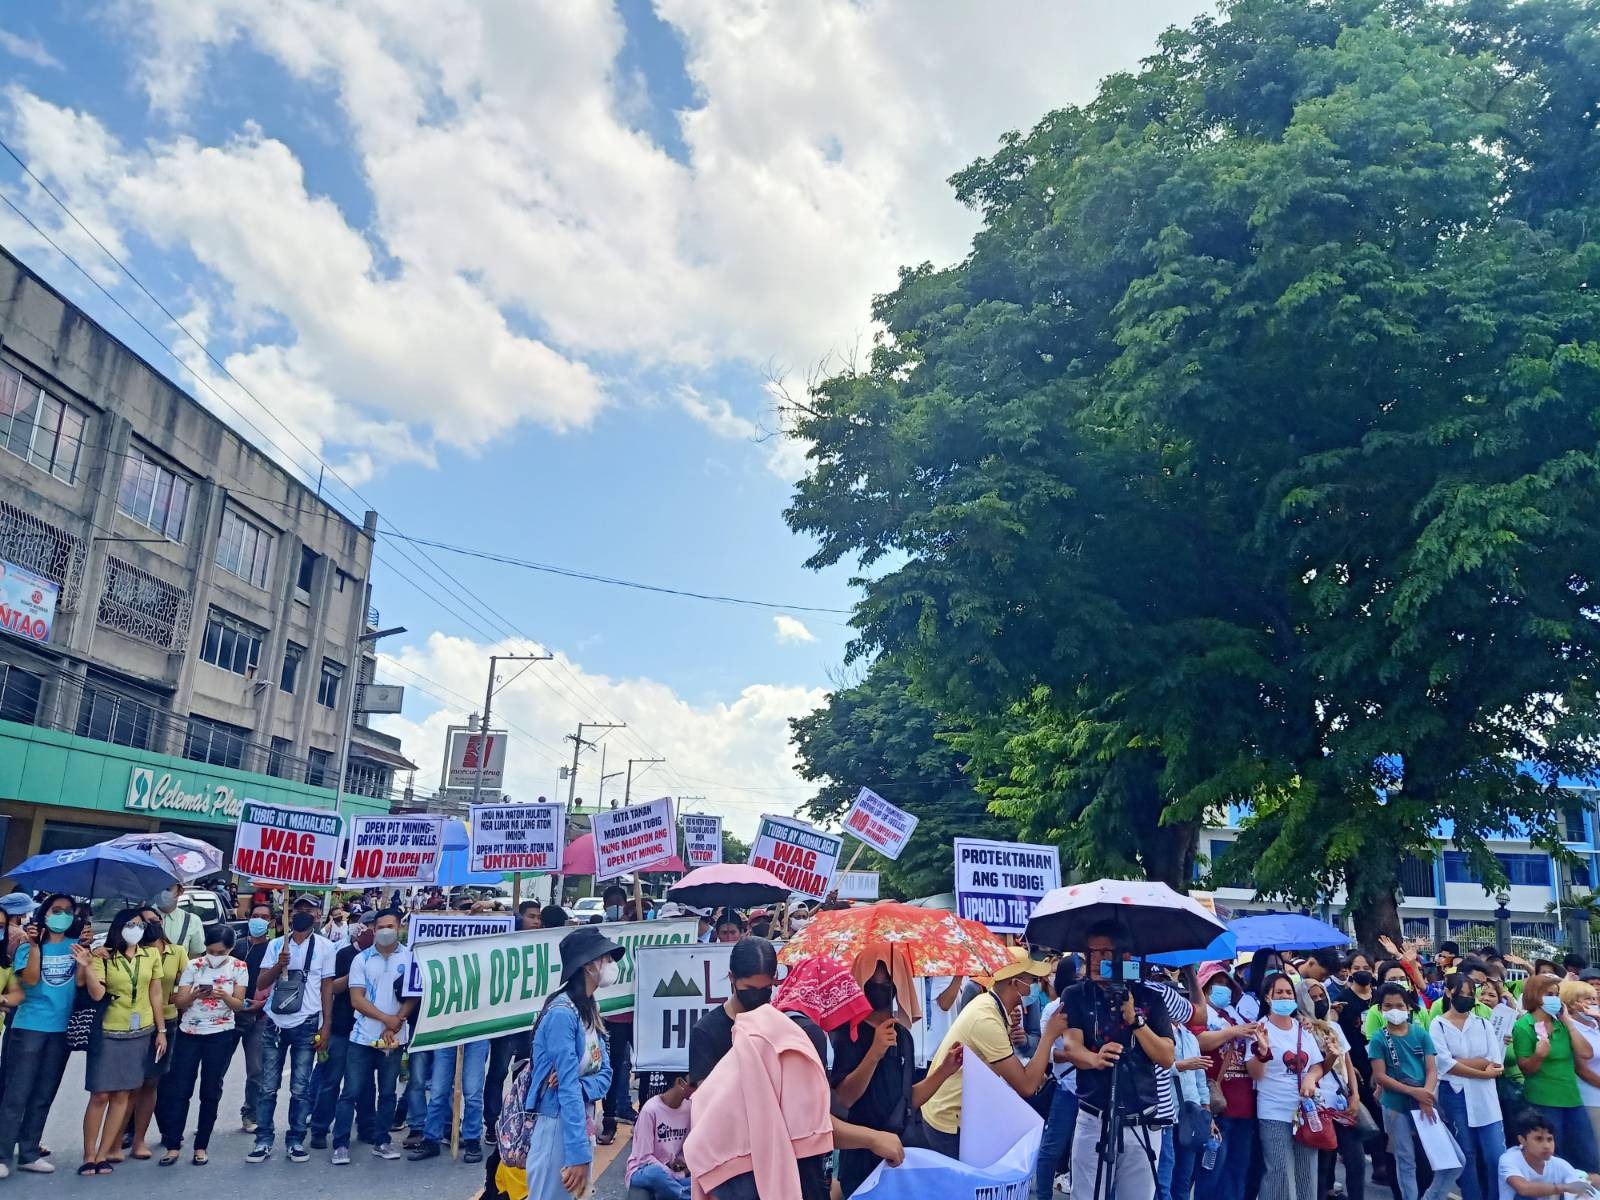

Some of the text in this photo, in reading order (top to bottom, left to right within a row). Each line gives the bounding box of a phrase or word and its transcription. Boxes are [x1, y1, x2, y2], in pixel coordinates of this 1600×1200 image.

[249, 806, 336, 835] TUBIG AY MAHALAGA
[480, 819, 552, 831] NGA LUHA NA LANG ATON
[495, 810, 504, 819] NA
[525, 808, 552, 819] HULATON
[612, 805, 652, 824] KITA TANAN
[849, 809, 870, 832] NO
[365, 822, 386, 833] OPEN
[387, 822, 401, 833] PIT
[604, 816, 662, 840] MADULAAN TUBIG
[767, 822, 836, 855] TUBIG AY MAHALAGA
[261, 827, 316, 857] WAG
[357, 834, 438, 846] DRYING UP OF WELLS.
[476, 844, 493, 855] OPEN
[493, 843, 504, 854] PIT
[529, 842, 545, 853] ATON
[545, 842, 554, 852] NA
[600, 828, 668, 855] KUNG MADAYON ANG
[236, 847, 333, 884] MAGMINA!
[351, 849, 383, 878] NO
[386, 852, 435, 864] TO OPEN PIT
[483, 853, 547, 869] UNTATON!
[607, 843, 665, 867] OPEN PIT MINING.
[773, 841, 817, 872] WAG
[961, 848, 1052, 870] PROTEKTAHAN
[382, 865, 419, 878] MINING!
[753, 856, 828, 897] MAGMINA!
[972, 870, 1044, 891] ANG TUBIG!
[963, 896, 1006, 923] UPHOLD
[1007, 899, 1029, 925] THE
[418, 923, 508, 937] PROTEKTAHAN
[427, 952, 481, 1018] BAN
[489, 942, 561, 1007] OPEN-
